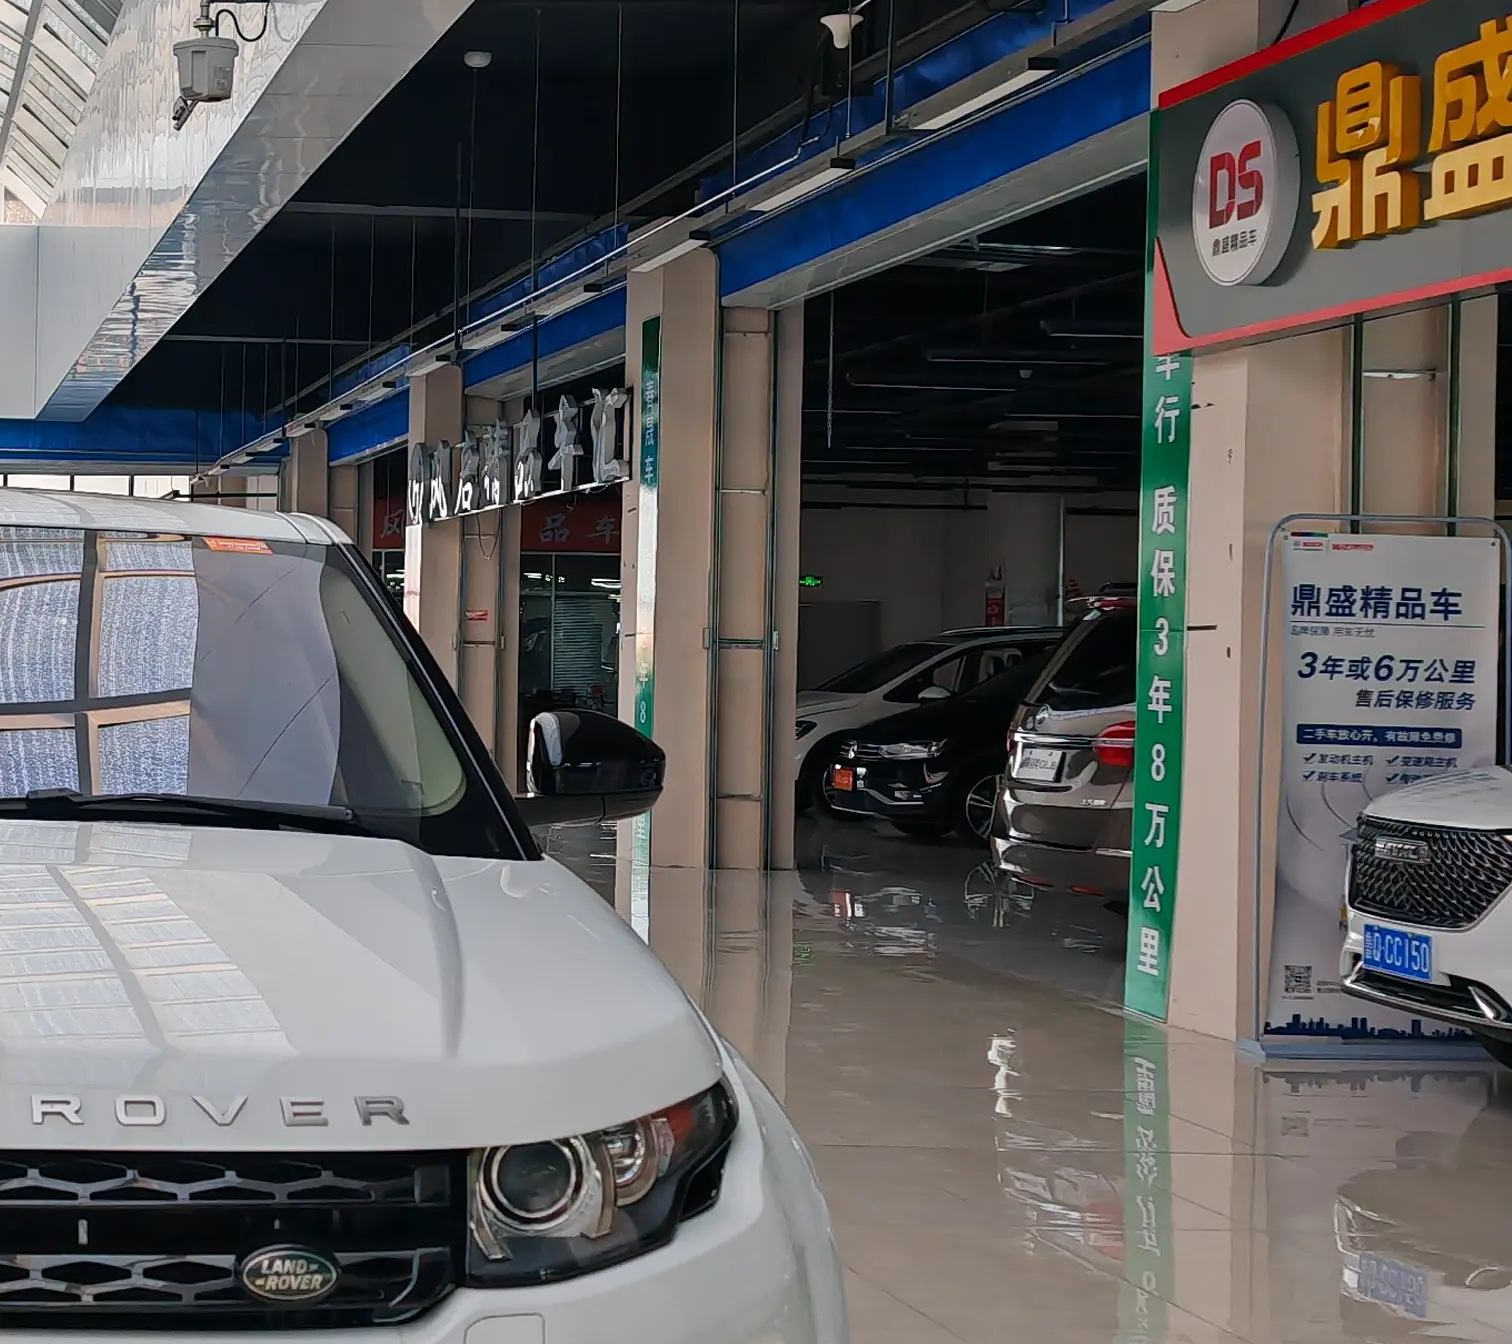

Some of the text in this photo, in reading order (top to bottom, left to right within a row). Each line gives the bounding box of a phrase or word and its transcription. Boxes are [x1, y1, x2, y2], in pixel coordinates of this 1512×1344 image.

[1208, 139, 1264, 230] DS
[1291, 583, 1463, 622] 鼎盛精品车
[1297, 651, 1477, 685] 3年或6万公里
[1355, 688, 1476, 711] 售后保修服务
[1136, 484, 1179, 977] 质保3年8万公里
[30, 1092, 412, 1128] ROVER
[261, 1259, 308, 1274] LAND
[264, 1274, 323, 1291] ROVER
